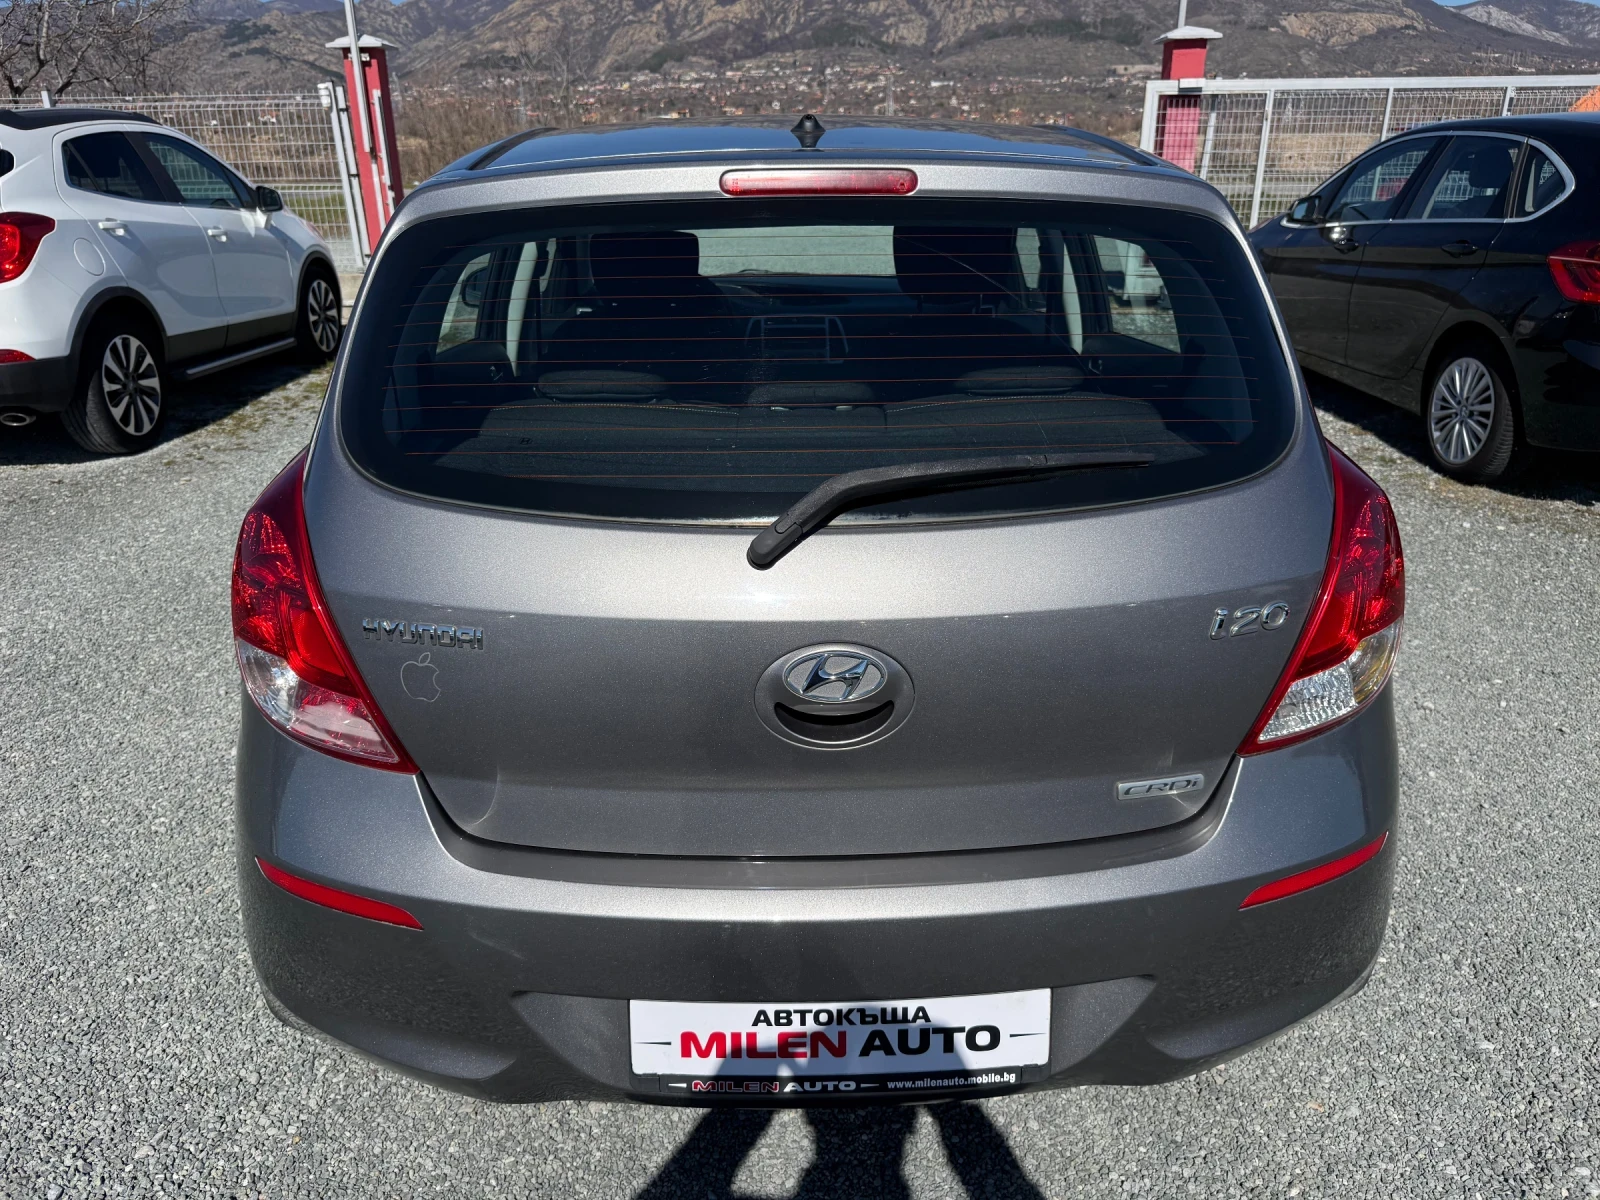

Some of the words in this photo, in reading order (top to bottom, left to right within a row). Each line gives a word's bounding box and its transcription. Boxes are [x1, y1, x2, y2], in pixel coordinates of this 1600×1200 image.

[362, 618, 484, 650] HYUNDAI
[1210, 601, 1290, 640] i20
[680, 1030, 847, 1059] MILEN
[858, 1024, 1001, 1057] AUTO
[691, 1080, 780, 1093] MILEN
[783, 1081, 857, 1093] AUTO
[886, 1072, 1016, 1089] www.milenauto.mobile.bg
